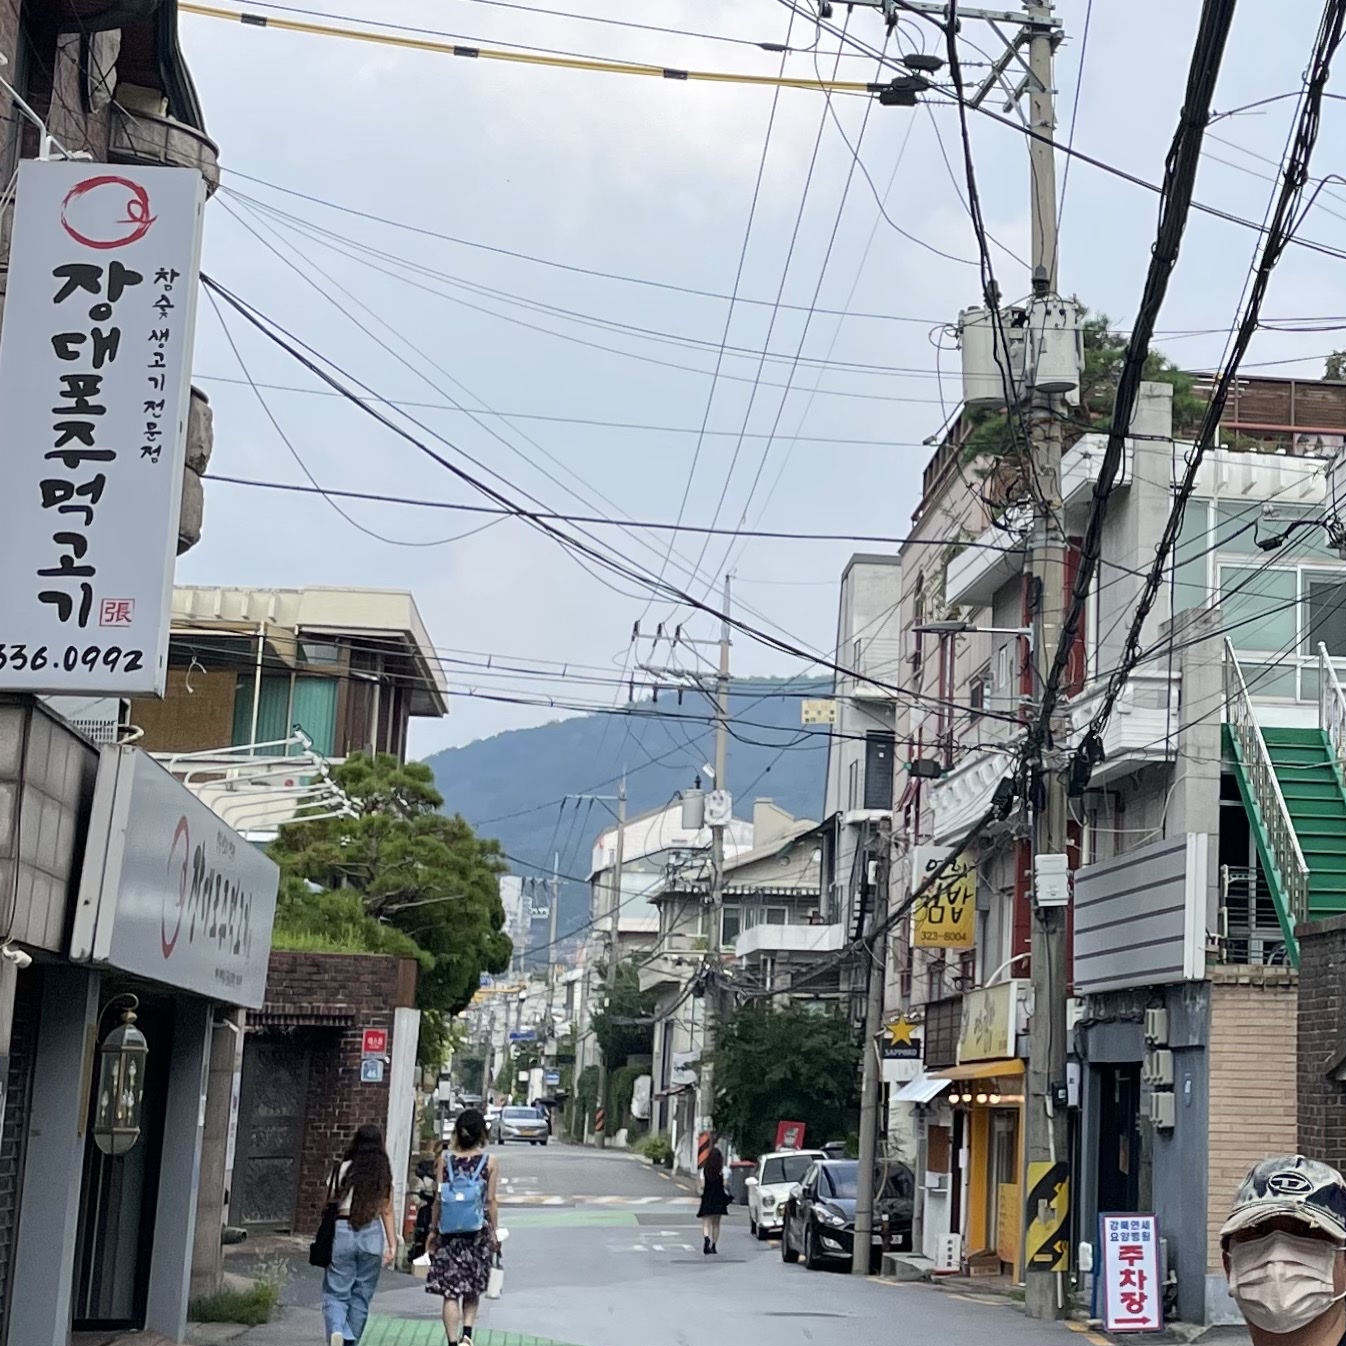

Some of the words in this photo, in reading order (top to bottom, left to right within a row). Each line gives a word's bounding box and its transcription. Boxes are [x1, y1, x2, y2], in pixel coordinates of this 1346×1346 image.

[38, 260, 144, 628] 장대포주먹고기
[920, 931, 967, 942] 323-8004
[1118, 1244, 1148, 1314] 주차장
